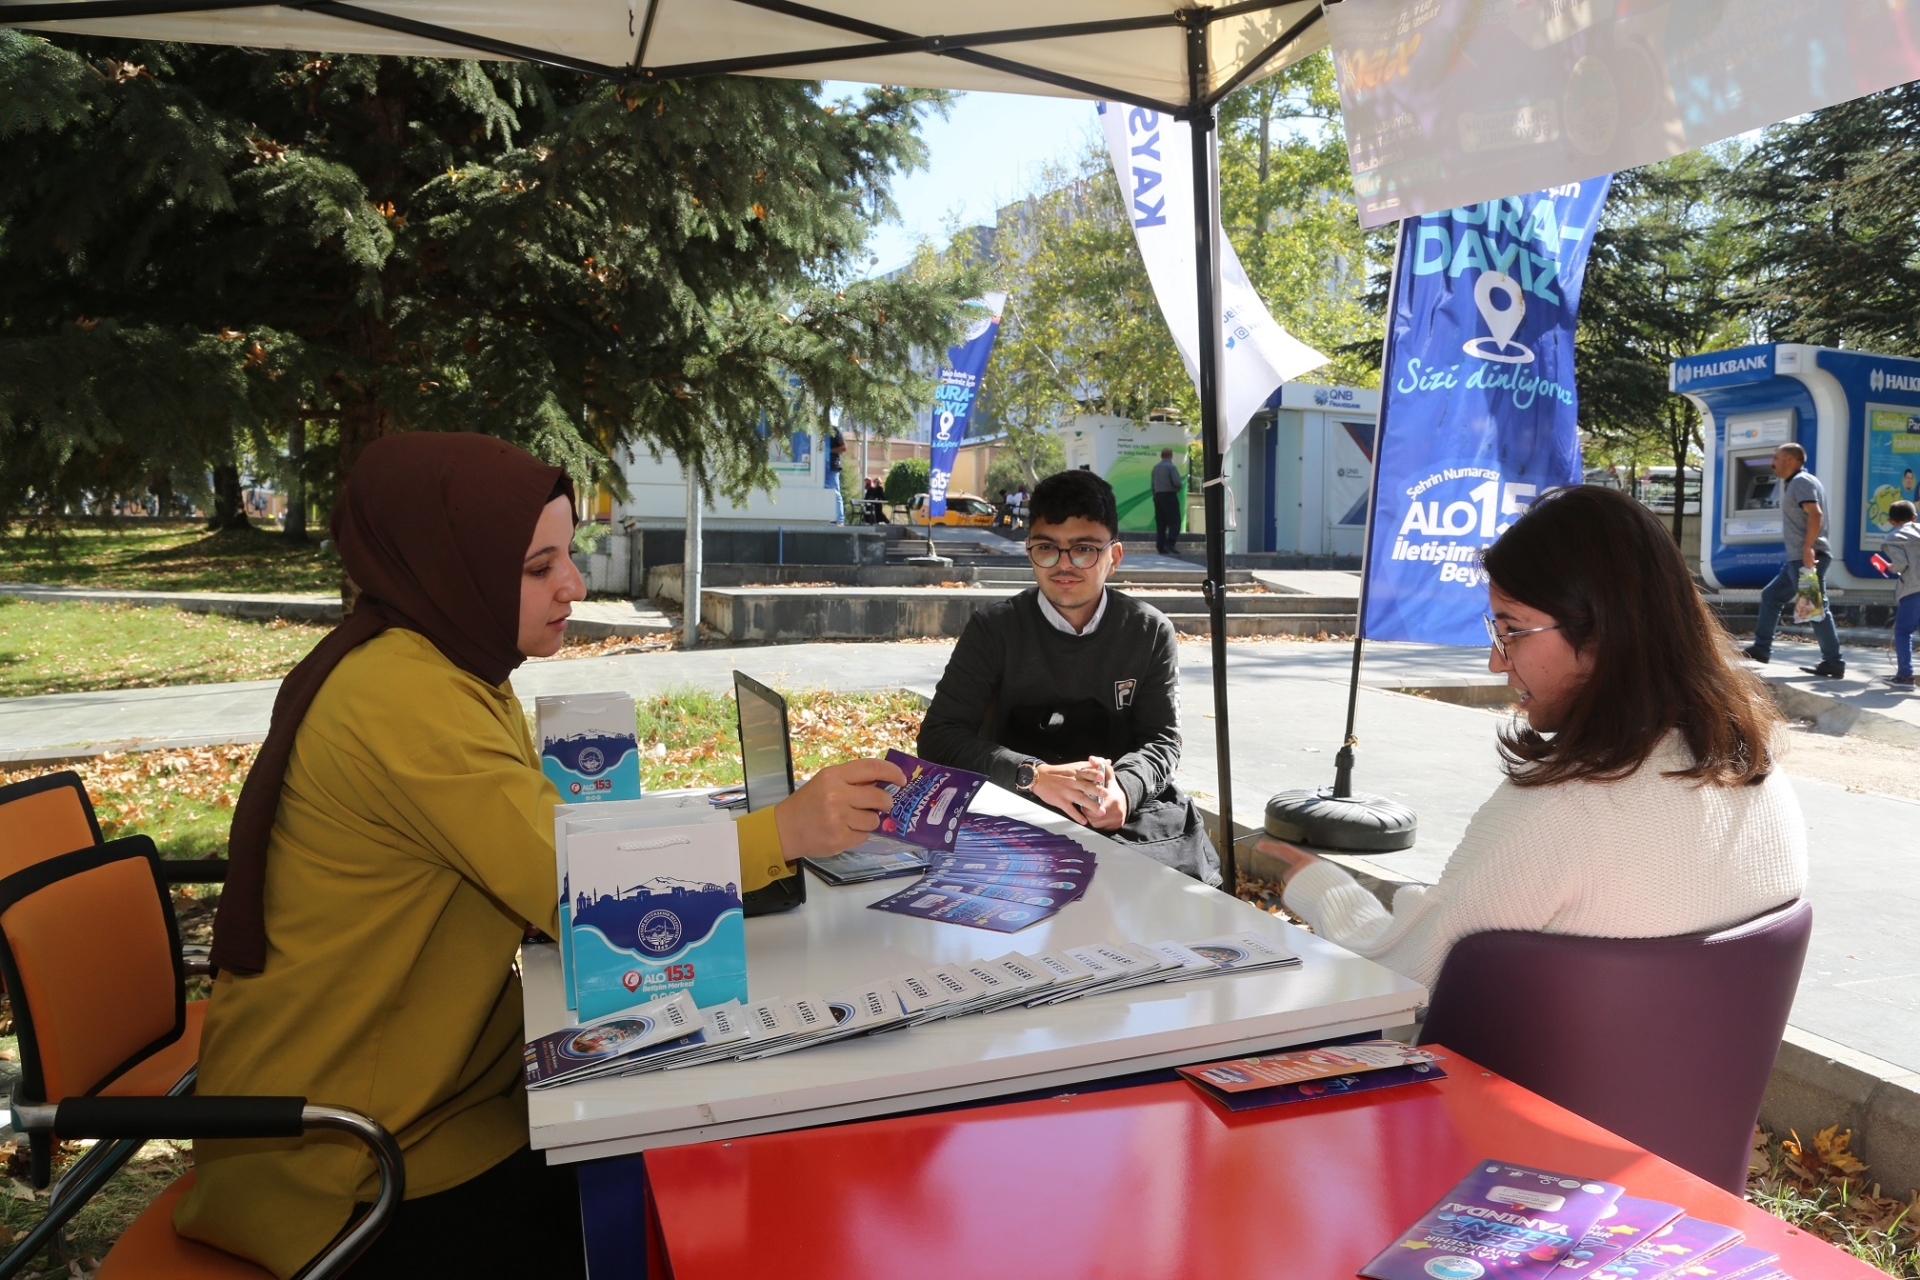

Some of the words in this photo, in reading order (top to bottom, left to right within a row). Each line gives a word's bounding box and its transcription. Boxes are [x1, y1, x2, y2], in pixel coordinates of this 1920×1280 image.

[1413, 225, 1561, 306] DAYIZ
[1693, 354, 1768, 378] HALKBANK
[1329, 389, 1353, 401] QNB
[1397, 358, 1459, 394] Sizi
[1466, 362, 1574, 410] dinliyoruz
[1406, 473, 1443, 501] Şehrin
[1444, 467, 1500, 482] Numarası
[1391, 537, 1478, 566] İletişim
[643, 983, 667, 993] İletişim
[668, 979, 695, 989] Merkezi
[796, 1000, 819, 1025] KAYSERİ
[866, 991, 886, 1016] KAYSERİ
[757, 1006, 780, 1030] KAYSERİ
[1440, 1203, 1569, 1236] YANINDA!
